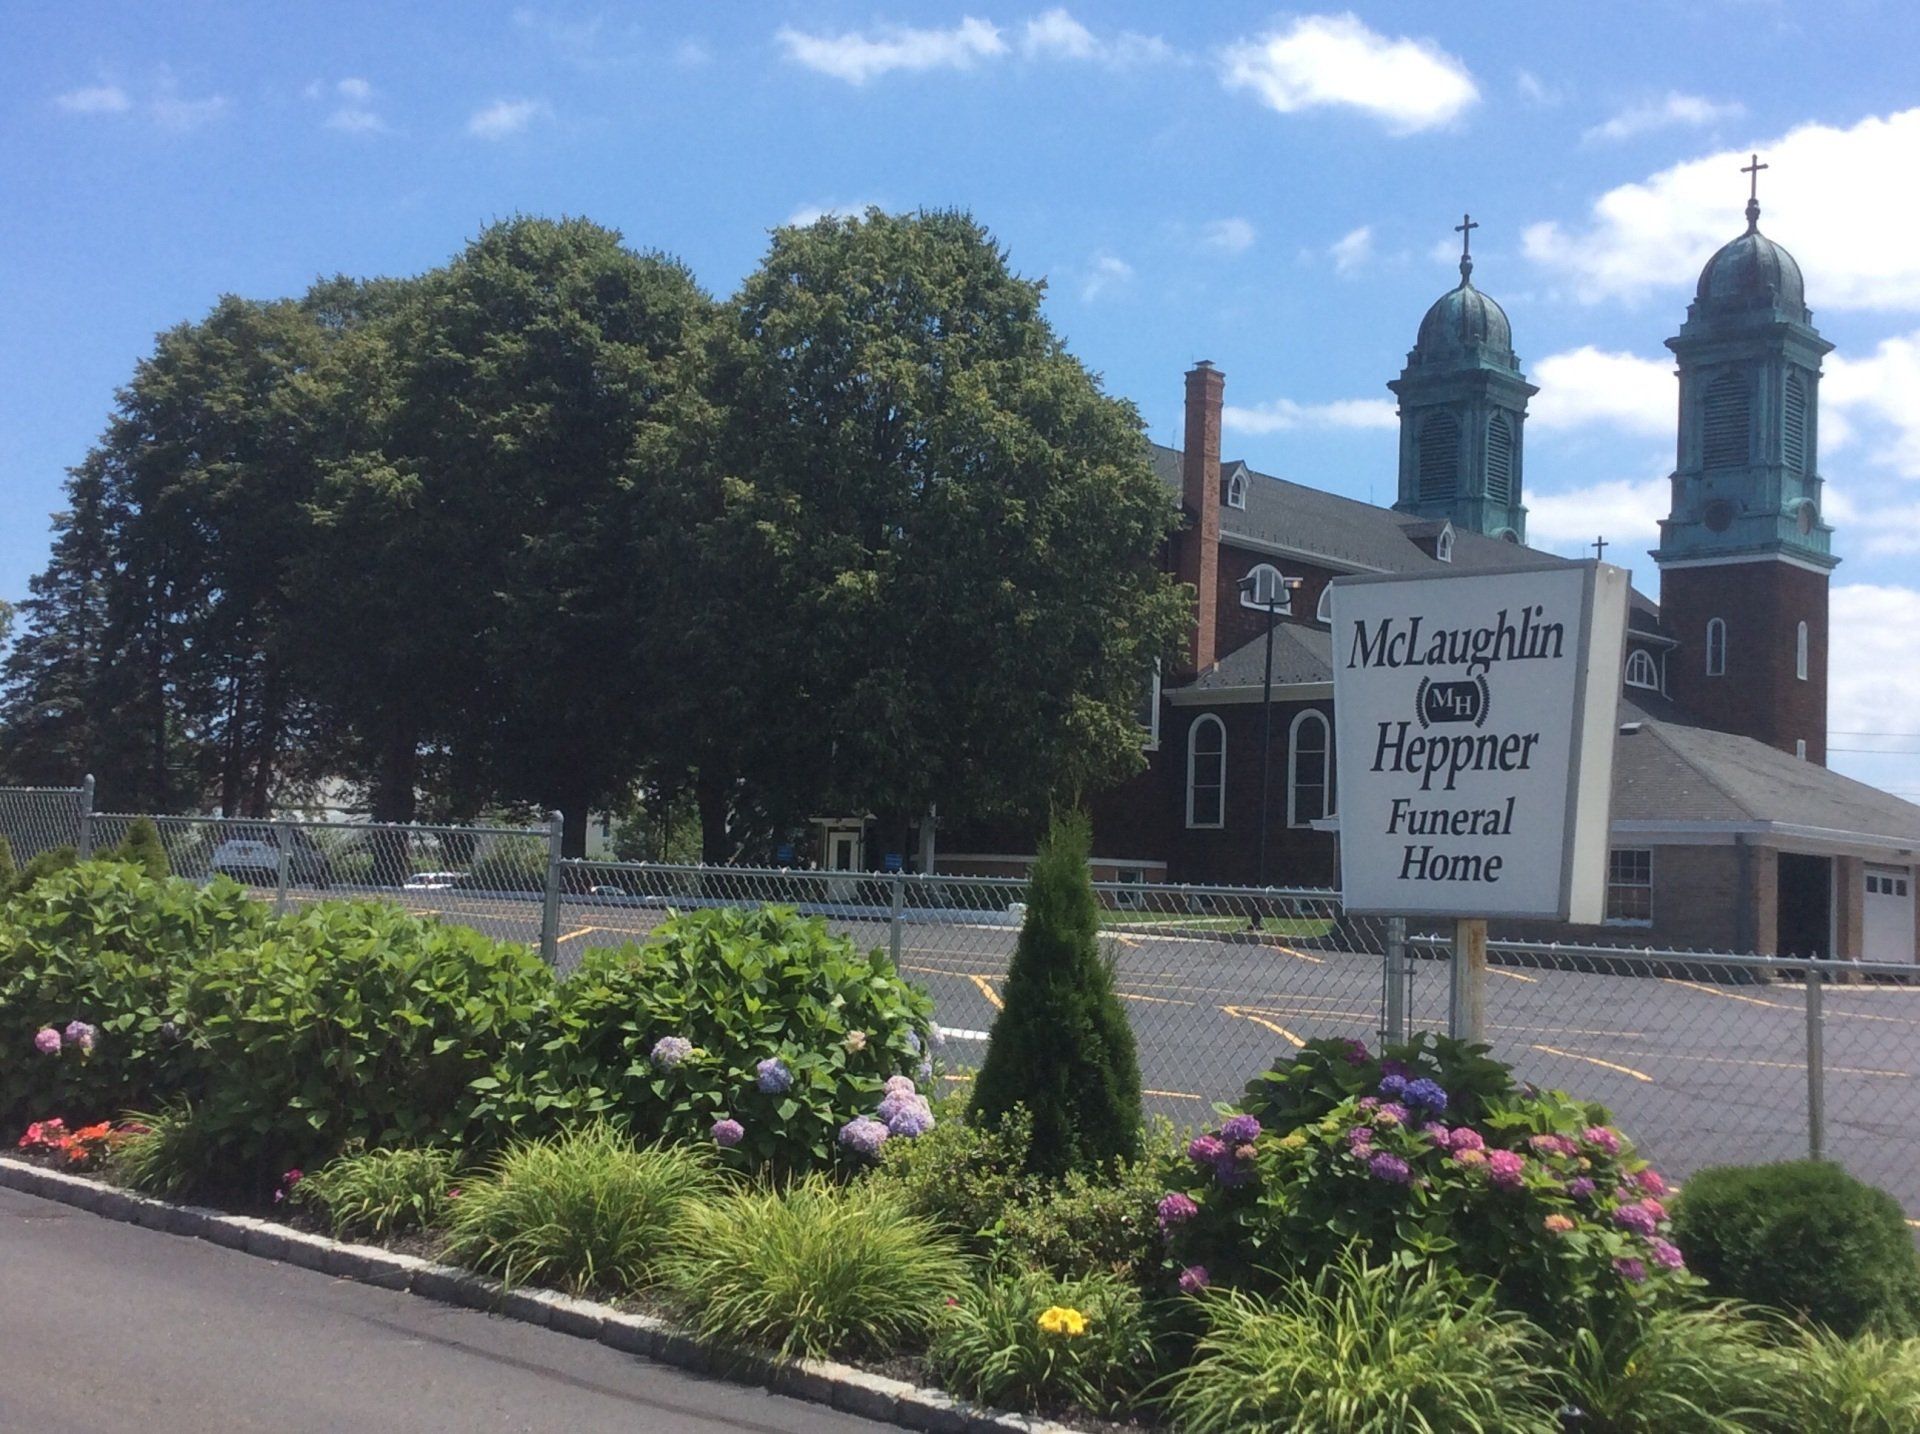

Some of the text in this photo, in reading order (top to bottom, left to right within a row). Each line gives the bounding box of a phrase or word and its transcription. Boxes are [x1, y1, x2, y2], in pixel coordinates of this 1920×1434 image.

[1347, 605, 1564, 676] McLaughlin
[1431, 687, 1473, 716] MH
[1370, 721, 1539, 790] Heppner
[1386, 797, 1516, 836] Funeral
[1398, 845, 1503, 882] Home
